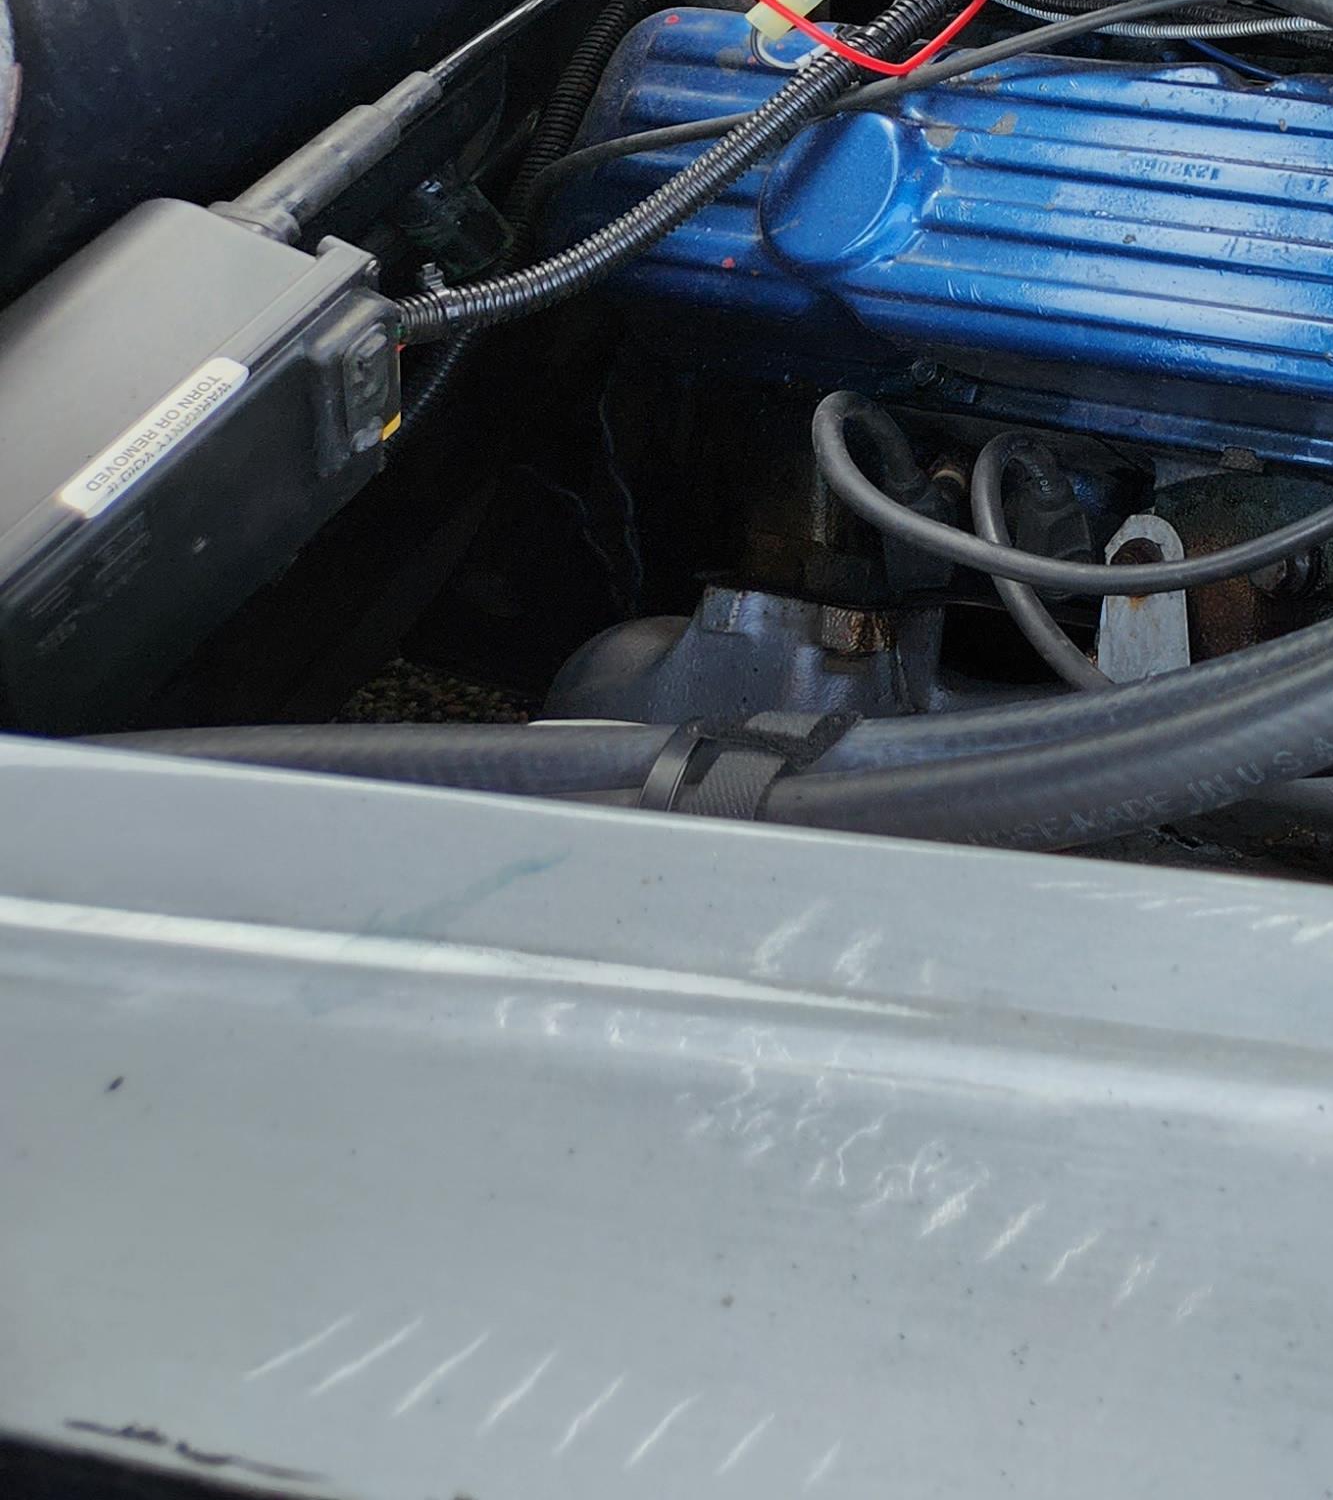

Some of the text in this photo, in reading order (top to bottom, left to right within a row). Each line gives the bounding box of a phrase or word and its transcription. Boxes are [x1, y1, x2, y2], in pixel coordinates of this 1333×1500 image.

[85, 375, 222, 492] TORN OR REMOVED
[157, 383, 232, 452] WARRANTY
[119, 451, 156, 482] VOID
[1070, 790, 1173, 835] MADE
[1187, 773, 1227, 804] IN
